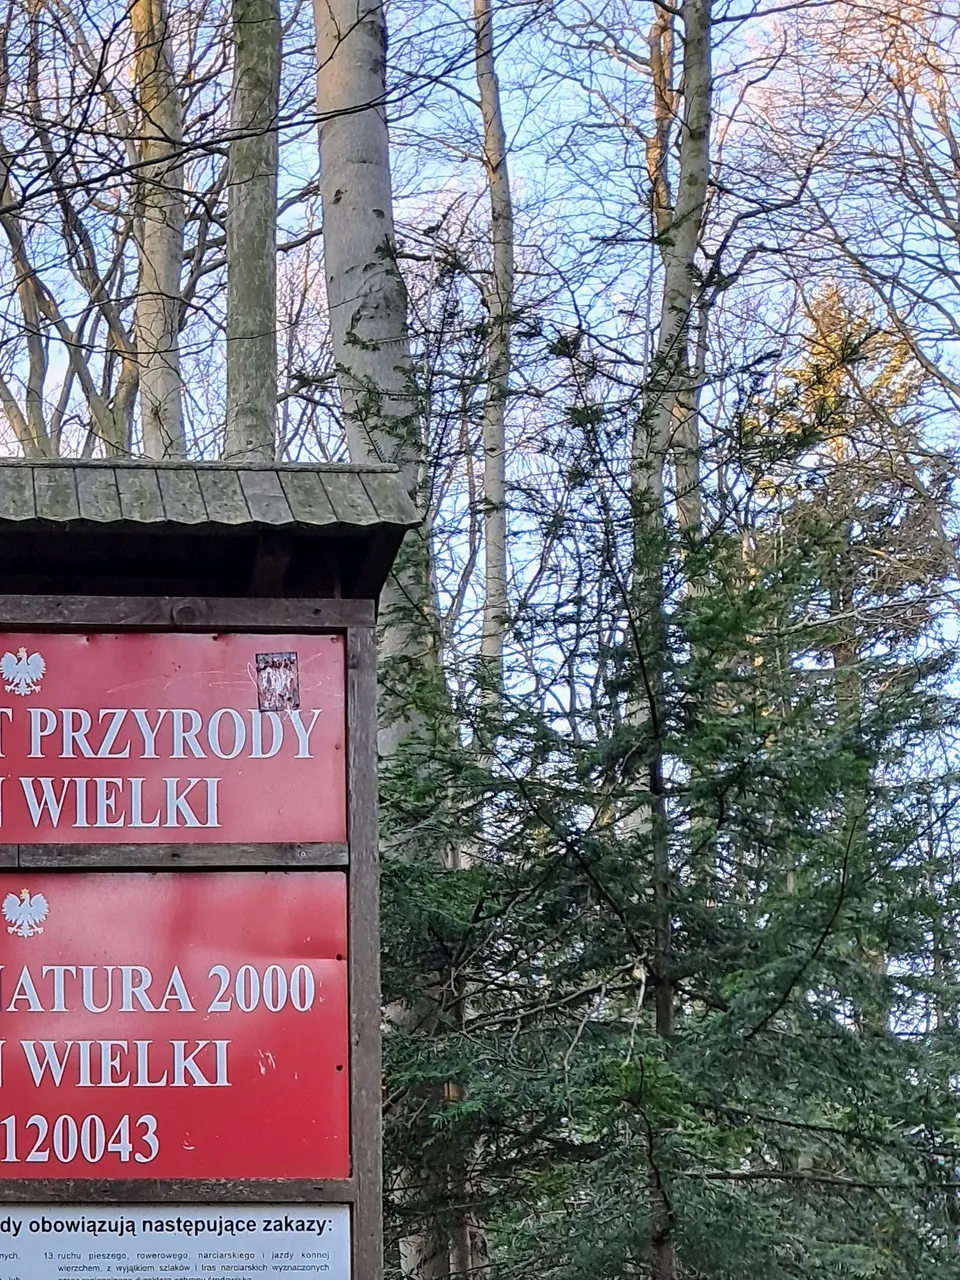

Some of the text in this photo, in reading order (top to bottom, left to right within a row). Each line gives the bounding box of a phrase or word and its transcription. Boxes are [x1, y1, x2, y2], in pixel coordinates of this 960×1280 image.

[27, 706, 322, 760] PRZYRODY
[18, 777, 223, 828] WIELKI
[207, 964, 315, 1013] 2000
[19, 1038, 233, 1088] WIELKI
[29, 1216, 136, 1236] obowiązują
[142, 1216, 256, 1236] następujące
[262, 1216, 332, 1236] zakazy:
